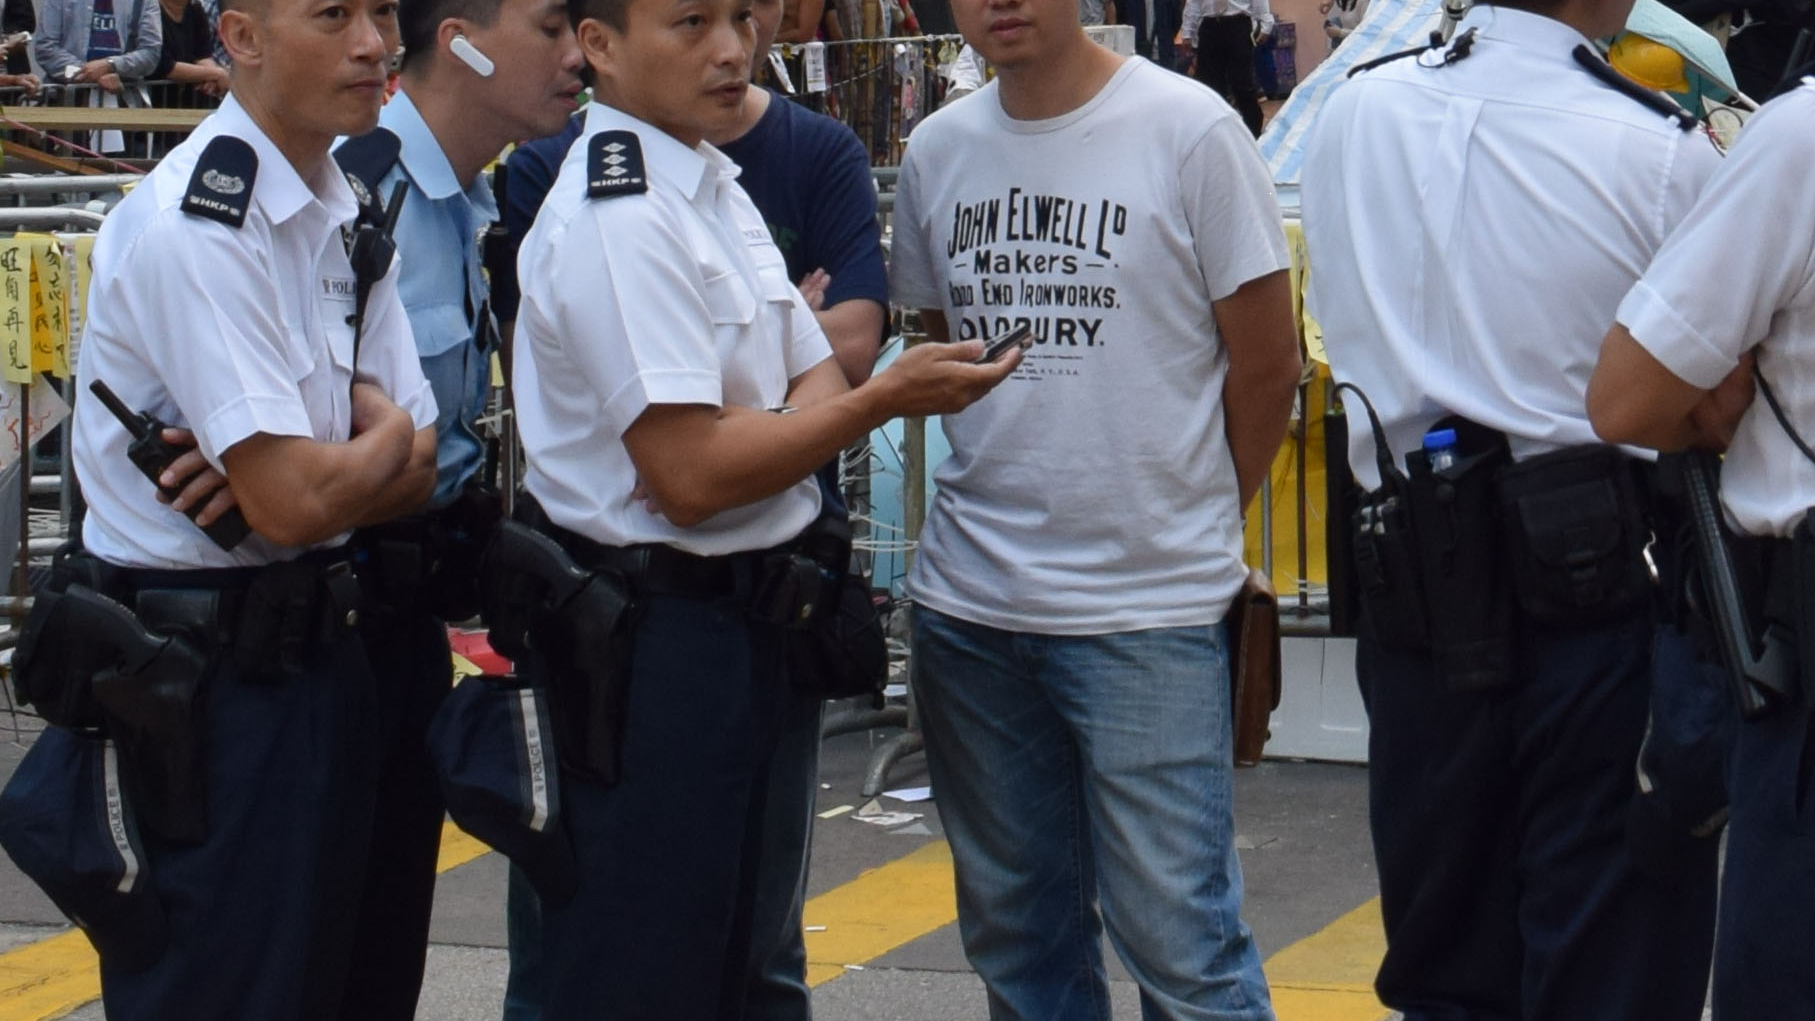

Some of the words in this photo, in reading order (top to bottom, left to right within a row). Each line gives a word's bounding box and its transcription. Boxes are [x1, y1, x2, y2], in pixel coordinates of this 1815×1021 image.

[199, 197, 229, 212] HKP
[948, 198, 1001, 259] JOHN
[1006, 187, 1087, 250] ELWELL
[973, 249, 1079, 276] Makers
[982, 279, 1013, 307] END
[1019, 280, 1121, 310] IRONWORKS.
